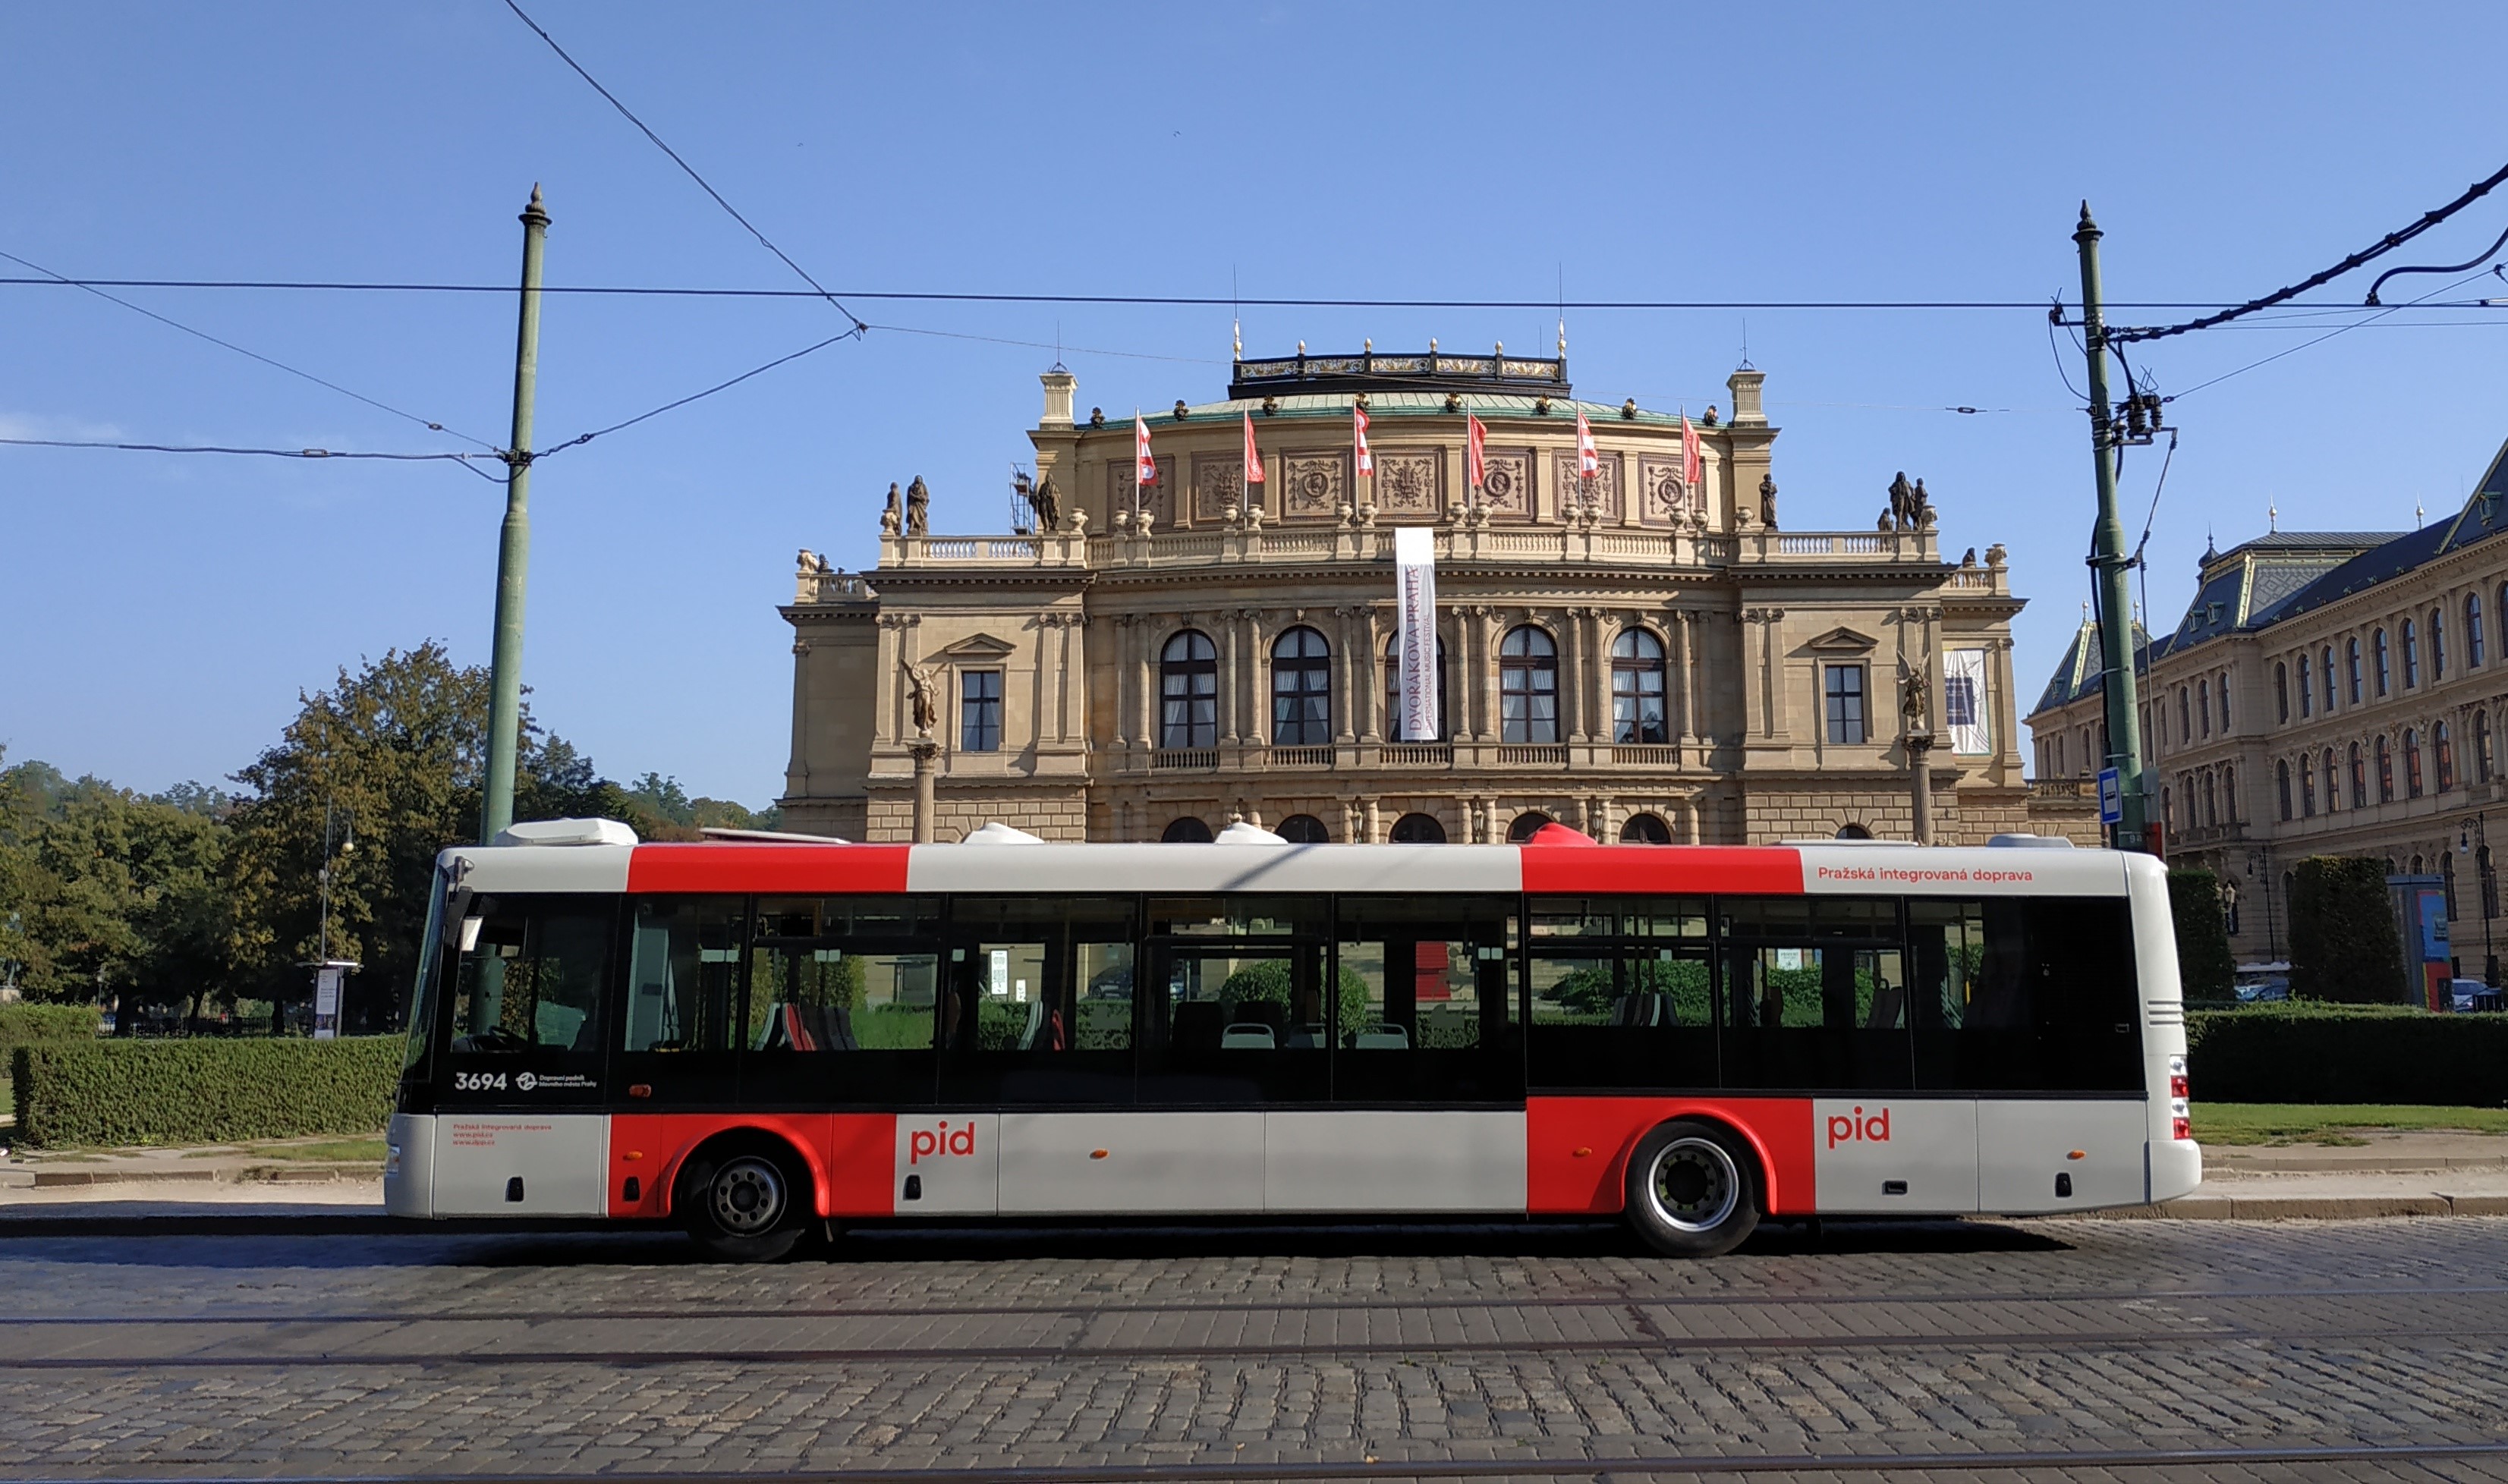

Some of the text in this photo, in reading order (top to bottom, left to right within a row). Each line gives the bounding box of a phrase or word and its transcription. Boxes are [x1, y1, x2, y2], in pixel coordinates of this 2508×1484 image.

[1423, 612, 1431, 646] FESTIVAL
[1405, 568, 1422, 731] DVOŘÁKOVA PRAHA
[1818, 866, 2033, 883] Pražská integrovaná doprava
[455, 1072, 507, 1090] 3694
[911, 1121, 974, 1165] pid
[1828, 1105, 1890, 1149] pid
